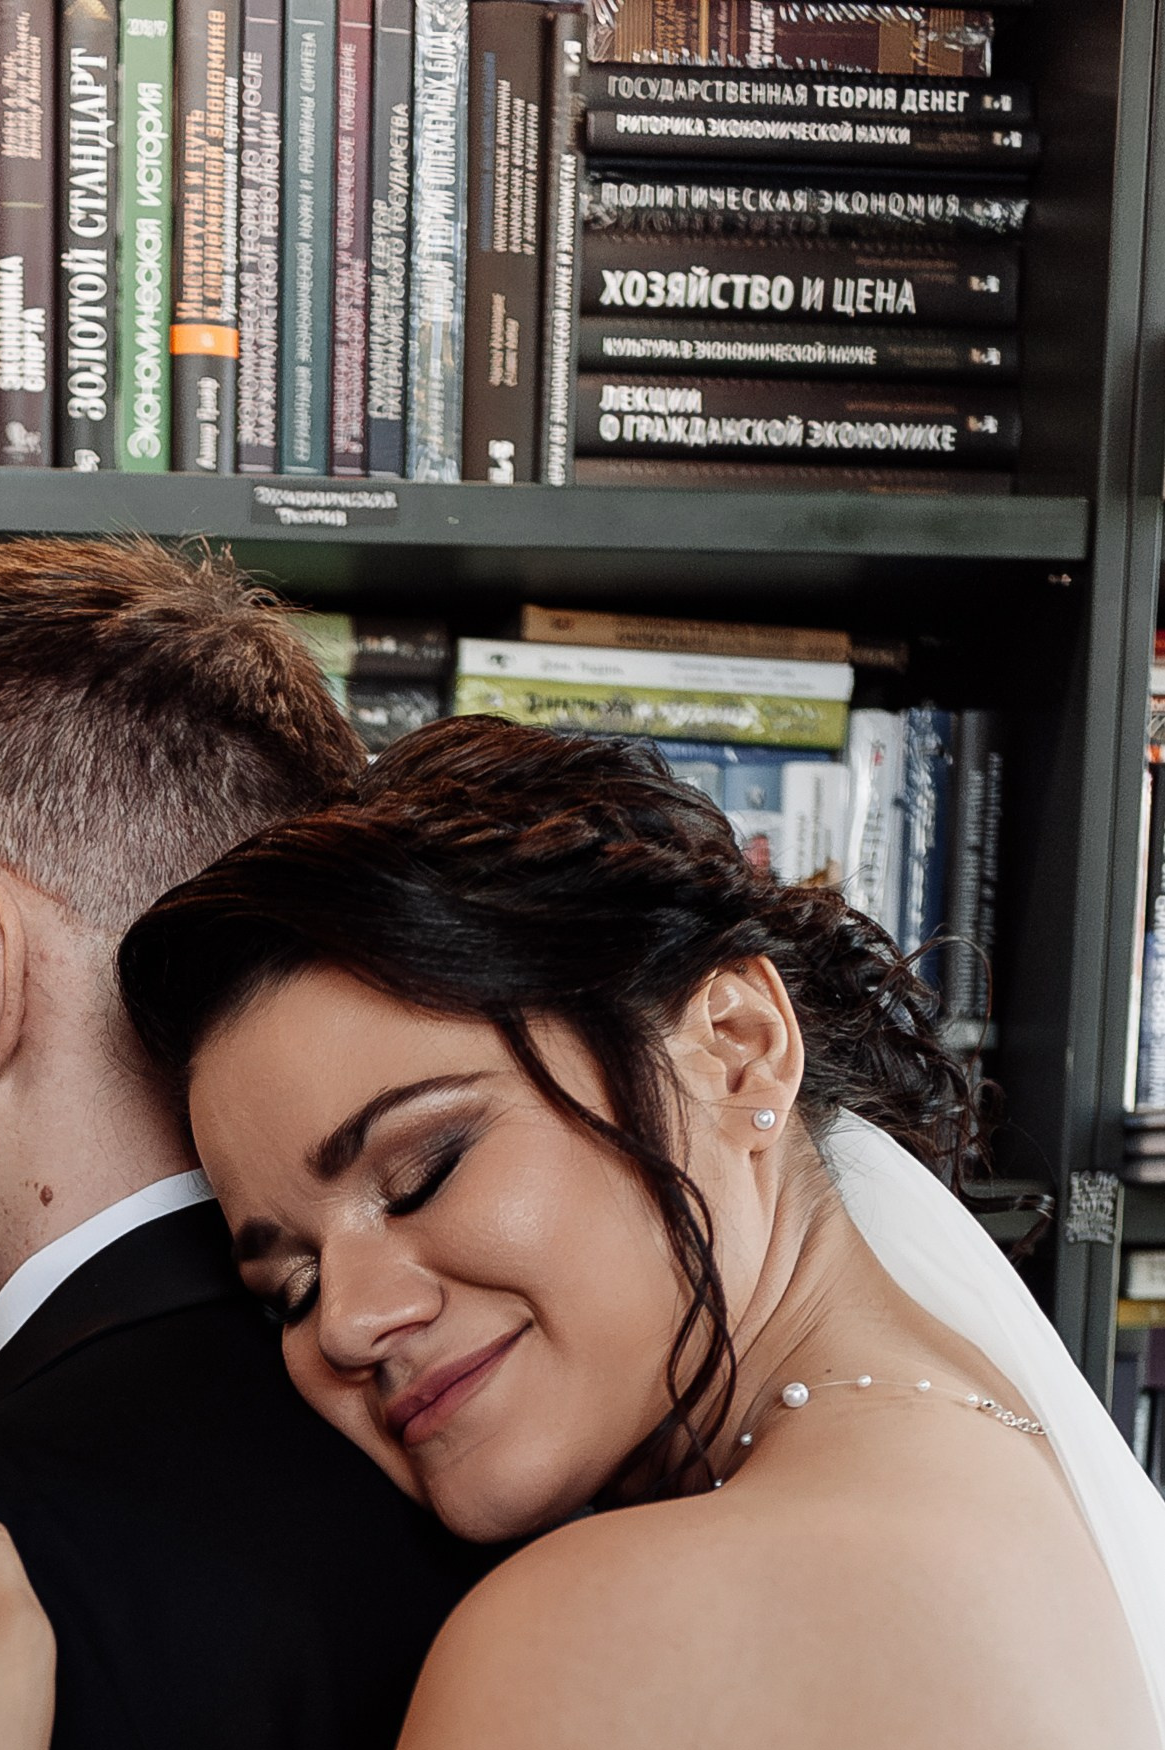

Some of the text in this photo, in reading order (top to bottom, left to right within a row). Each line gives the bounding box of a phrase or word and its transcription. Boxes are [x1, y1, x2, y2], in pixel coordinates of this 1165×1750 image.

[299, 32, 318, 93] СИНТЕЗА
[420, 28, 458, 73] БЛАГ
[338, 42, 359, 132] ПОВЕДЕНИЕ
[606, 75, 971, 115] ГОСУДАРСТВЕННАЯ ТЕОРИЯ ДЕНЕГ
[298, 95, 318, 175] ПРОБЛЕМЫ
[419, 77, 457, 187] ОПЕКАЕМЫХ
[615, 113, 912, 146] РИТОРИКА ЭКОНОМИЧЕСКОЙ НАУКИ
[259, 110, 283, 239] РЕВОЛЮЦИИ
[388, 101, 411, 232] ГОСУДАРСТВА
[555, 153, 578, 249] ЭКОНОМИСТАХ
[600, 182, 960, 221] ПОЛИТИЧЕСКАЯ ЭКОНОМИЯ
[60, 46, 117, 422] ЗОЛОТОЙ СТАНДАРТ
[237, 50, 265, 446] ЭКОНОМИЧЕСКАЯ ТЕОРИЯ ДО И ПОСЛЕ
[297, 193, 316, 239] НАУКИ
[371, 198, 394, 270] СЕКТОР
[553, 263, 575, 308] НАУКЕ
[598, 265, 917, 318] ХОЗЯЙСТВО И ЦЕНА
[21, 306, 47, 393] СПОРТА
[126, 217, 163, 460] Экономическая
[550, 308, 574, 423] ЭКОНОМИЧЕСКОЙ
[602, 337, 679, 361] КУЛЬТУРА
[693, 339, 829, 364] ЭКОНОМИЧЕСКОЙ
[829, 344, 878, 366] НАУКЕ
[599, 386, 704, 415] ЛЕКЦИИ
[599, 414, 959, 453] О ГРАЖДАНСКОЙ ЭКОНОМИКЕ
